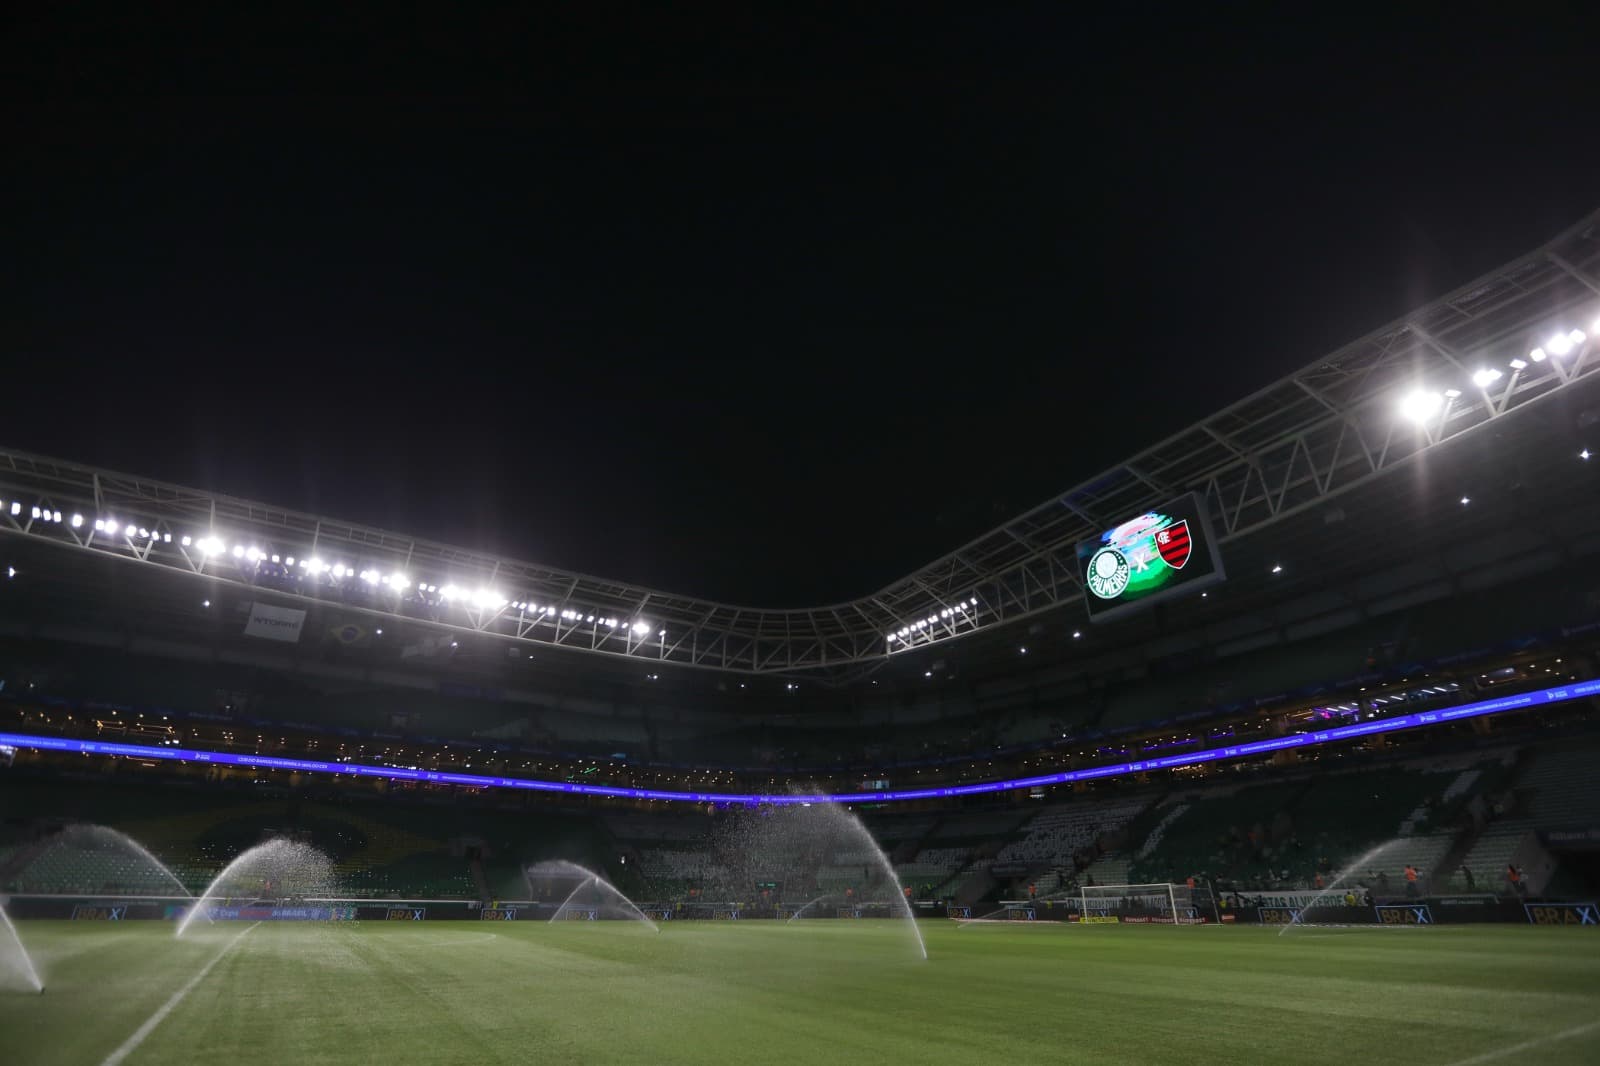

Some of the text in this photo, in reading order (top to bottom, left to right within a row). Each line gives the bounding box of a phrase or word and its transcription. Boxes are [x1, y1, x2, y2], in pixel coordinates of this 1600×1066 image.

[1090, 565, 1128, 595] PALMEIRAS
[390, 909, 422, 920] BRAX
[484, 909, 513, 920] BRAX
[1264, 910, 1301, 923] BRAX
[1381, 907, 1429, 924] BRAX
[1535, 906, 1597, 925] BRAX
